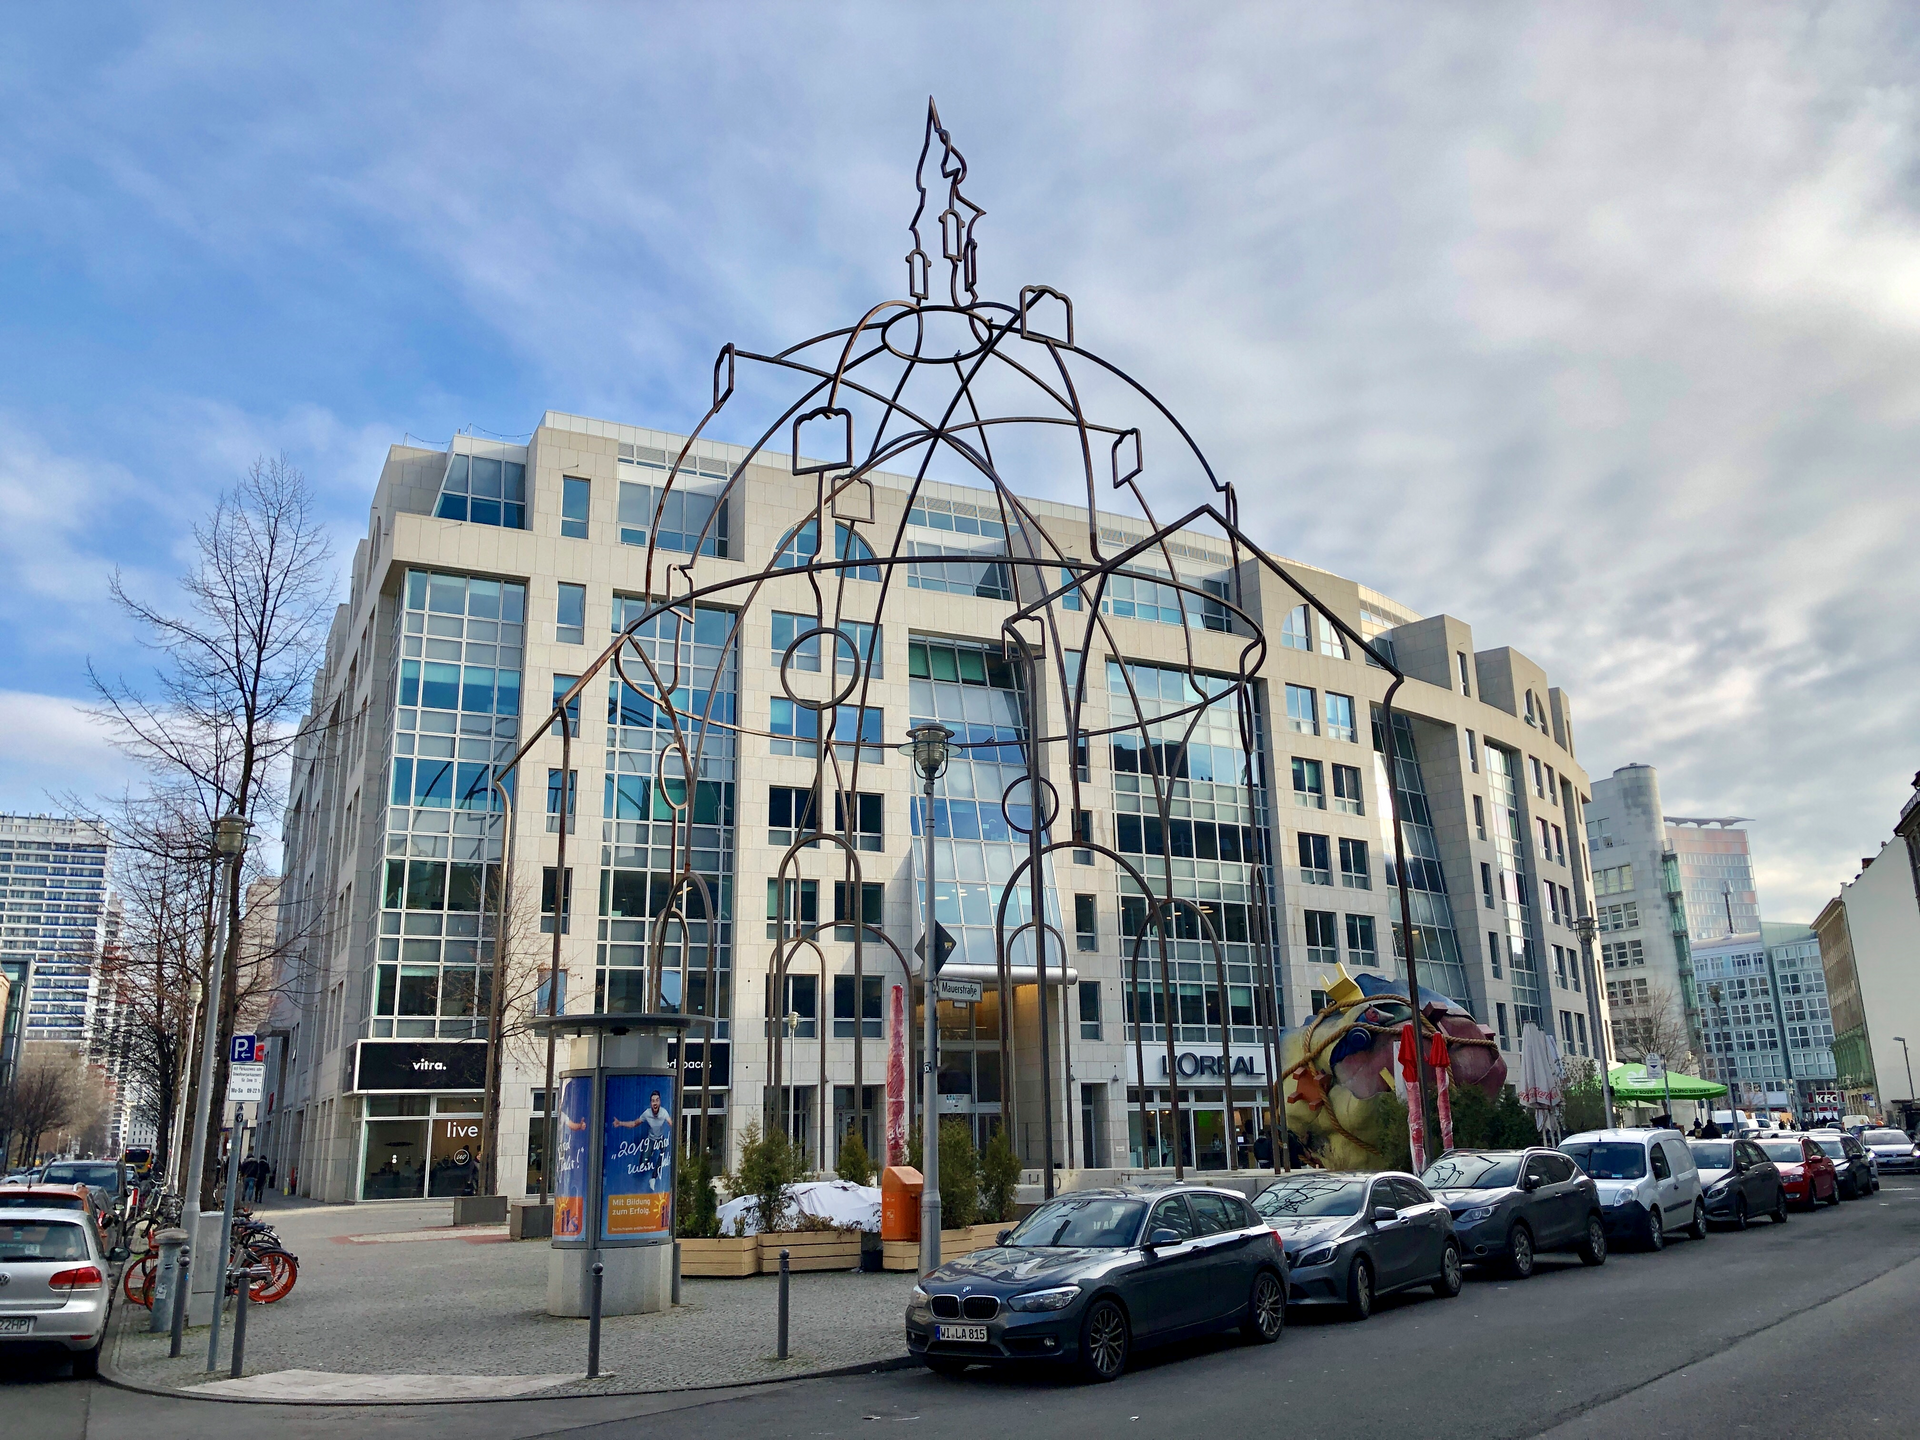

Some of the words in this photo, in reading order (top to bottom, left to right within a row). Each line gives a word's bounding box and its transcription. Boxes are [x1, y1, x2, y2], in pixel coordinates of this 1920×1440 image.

[941, 982, 977, 998] Mauerstraße
[234, 1038, 248, 1059] P
[412, 1058, 447, 1071] vitra.
[1815, 1094, 1838, 1103] KFC
[446, 1121, 479, 1138] live
[627, 1158, 655, 1175] mein
[626, 1198, 651, 1206] Bildung
[629, 1207, 651, 1215] Erfolg.
